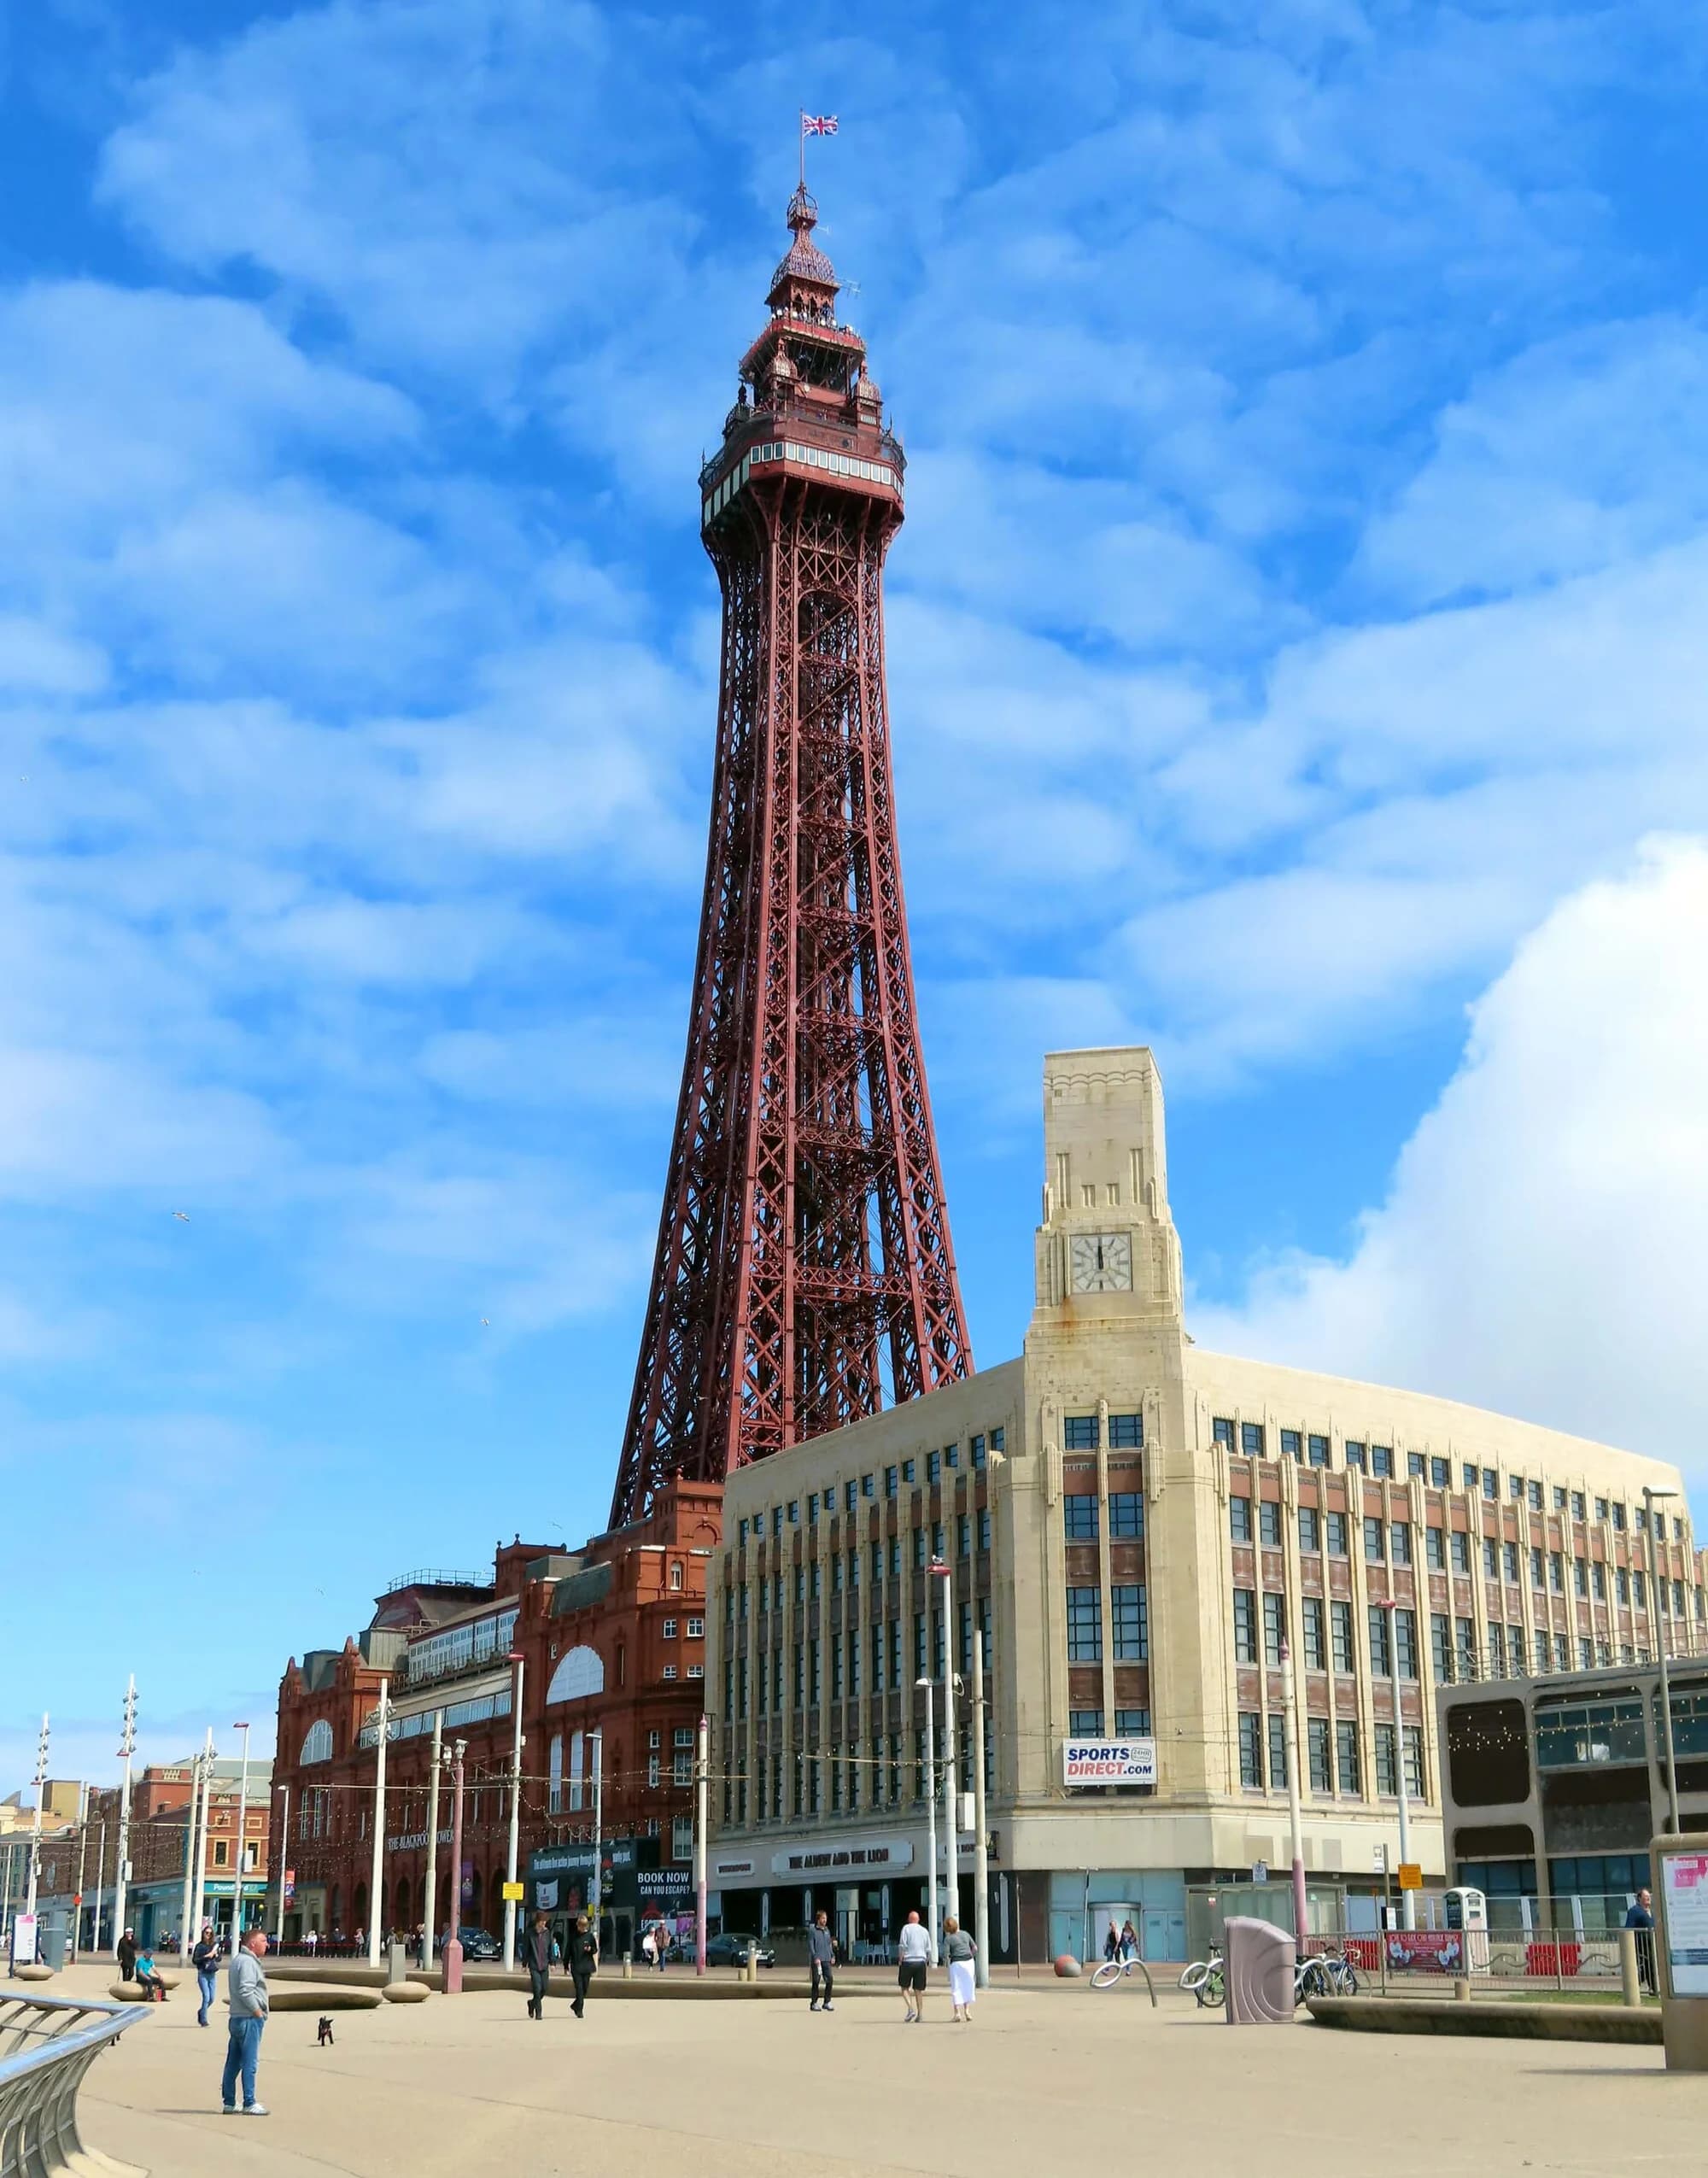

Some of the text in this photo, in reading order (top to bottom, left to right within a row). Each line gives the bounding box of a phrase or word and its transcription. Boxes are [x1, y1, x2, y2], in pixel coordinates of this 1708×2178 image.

[1068, 1748, 1130, 1761] SPORTS
[1068, 1762, 1152, 1776] DIRECT.COM
[389, 1830, 454, 1851] THE BLACKPOO OWER
[788, 1855, 803, 1869] THE
[833, 1852, 850, 1866] AND
[851, 1850, 866, 1864] THE
[868, 1848, 889, 1863] LION
[637, 1871, 689, 1883] BOOK NOW
[640, 1885, 690, 1894] CAN YOU ESCAPE?
